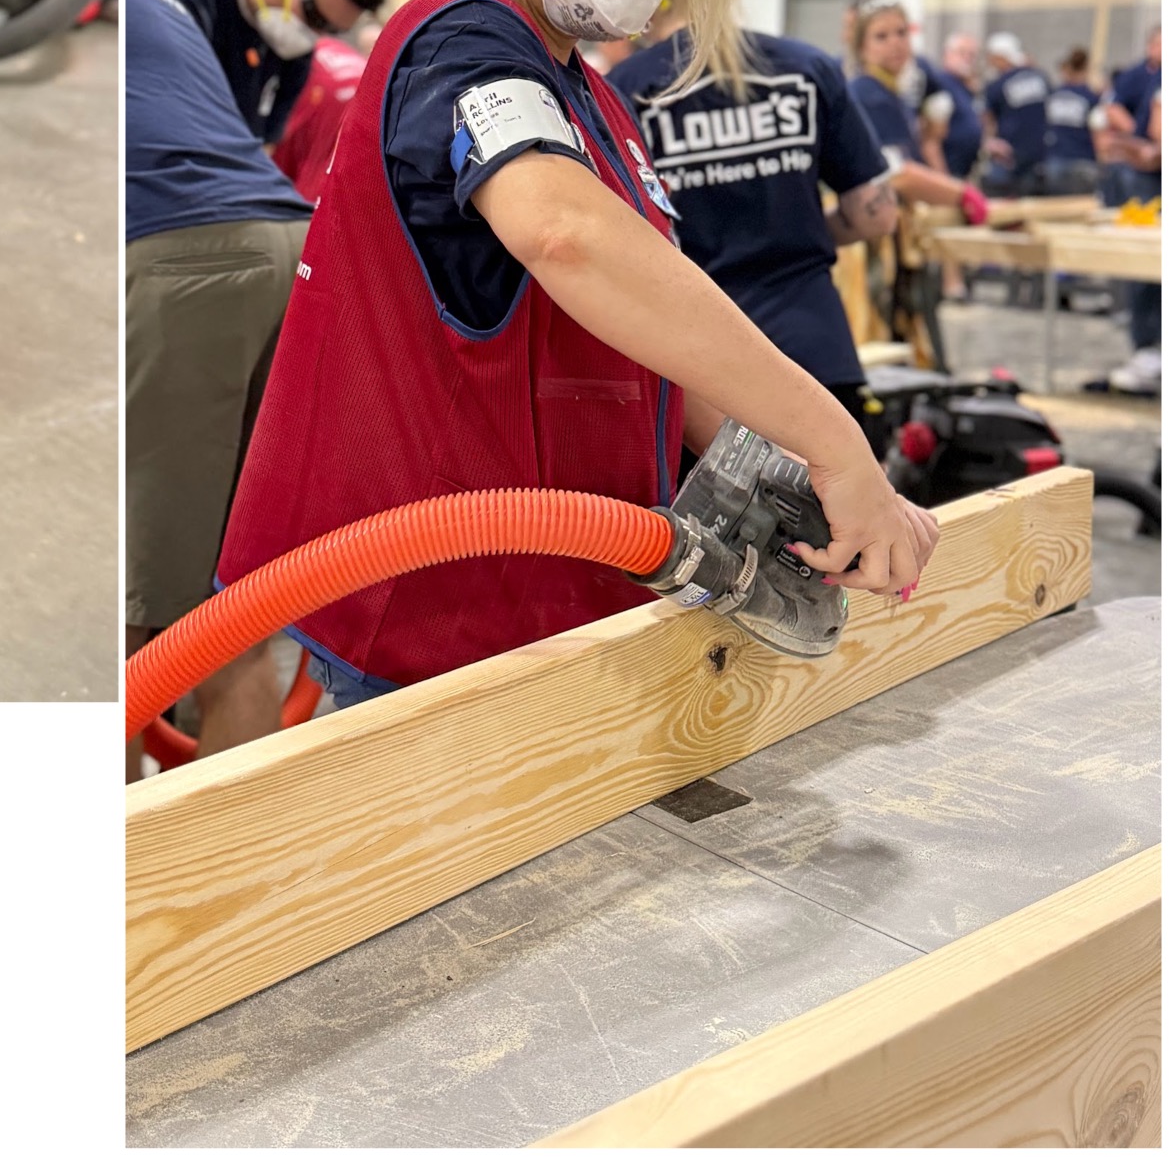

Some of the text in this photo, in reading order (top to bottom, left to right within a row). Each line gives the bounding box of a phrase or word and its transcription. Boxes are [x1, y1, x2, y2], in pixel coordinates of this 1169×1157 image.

[469, 91, 498, 112] Aril
[658, 92, 803, 156] LOWE'S
[660, 168, 705, 192] e're
[706, 163, 756, 186] Here
[757, 157, 781, 177] to
